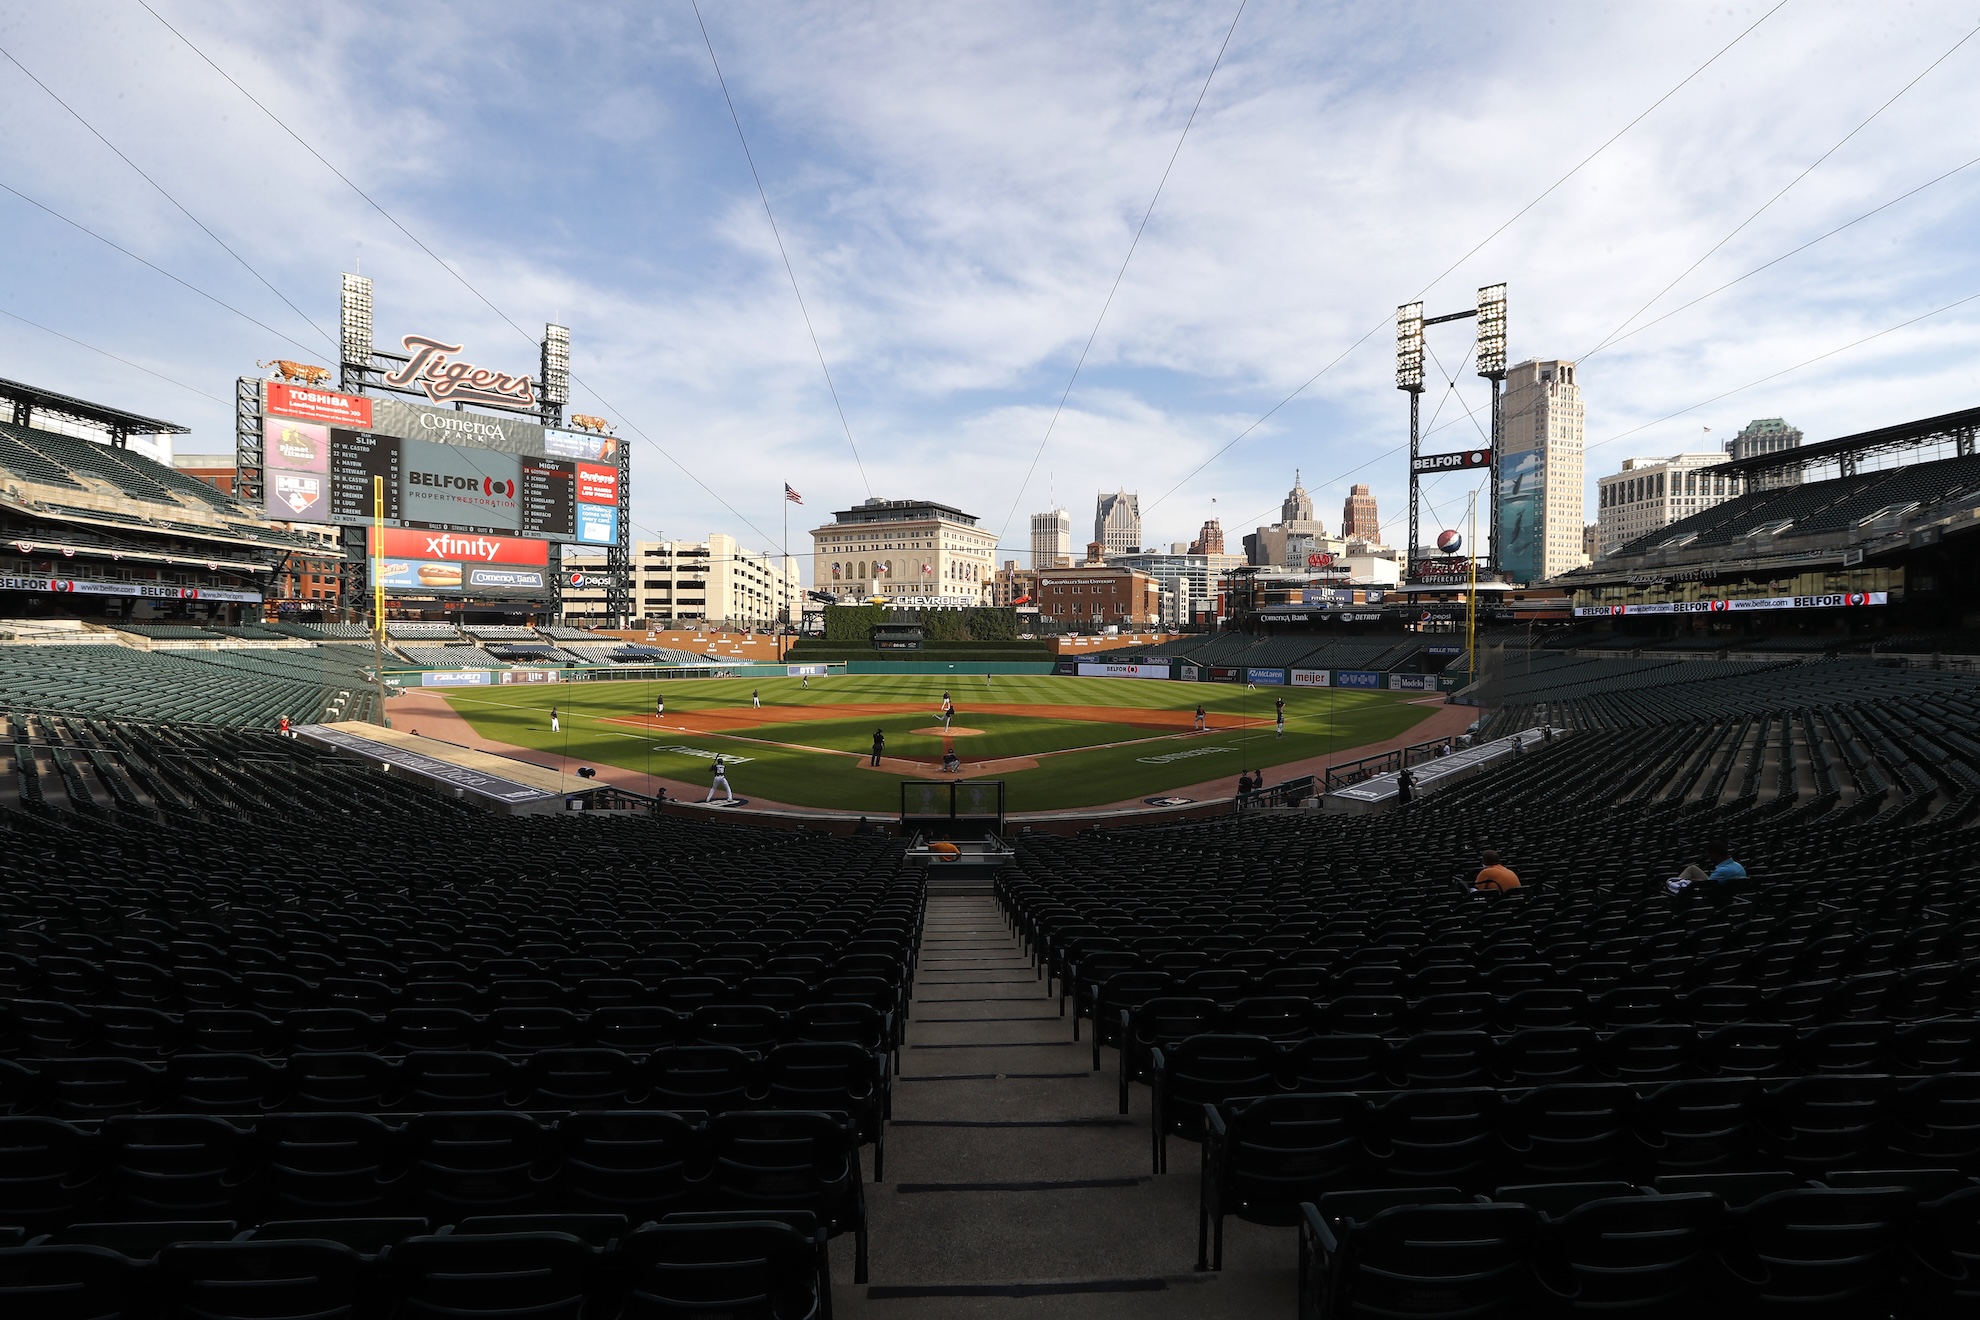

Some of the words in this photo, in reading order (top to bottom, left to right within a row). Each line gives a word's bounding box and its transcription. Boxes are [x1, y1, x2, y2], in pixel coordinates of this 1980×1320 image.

[384, 334, 536, 406] Tigers
[289, 390, 349, 408] TOSHIBA
[289, 401, 315, 410] Leading
[316, 404, 349, 415] Innovation
[445, 430, 484, 441] PARK
[356, 437, 376, 445] SLIM
[279, 444, 308, 453] planet
[283, 450, 315, 459] fitness
[1414, 455, 1462, 469] BELFOR
[409, 471, 479, 491] BELFOR
[582, 505, 612, 514] Confidence
[426, 534, 500, 560] xfinity
[516, 575, 537, 584] Bank
[584, 577, 611, 586] pepsi
[81, 584, 135, 593] www.belfor.com
[141, 587, 178, 597] BELFOR
[1321, 588, 1336, 596] Lite
[897, 596, 974, 604] CHEVROLET
[1735, 600, 1788, 608] www.belfor.com
[1794, 596, 1841, 607] BELFOR
[1674, 602, 1708, 611] BELFOR
[528, 673, 543, 681] Lite
[1295, 672, 1326, 683] meijer
[1402, 679, 1423, 687] Modelo
[434, 768, 495, 786] TIGERS
